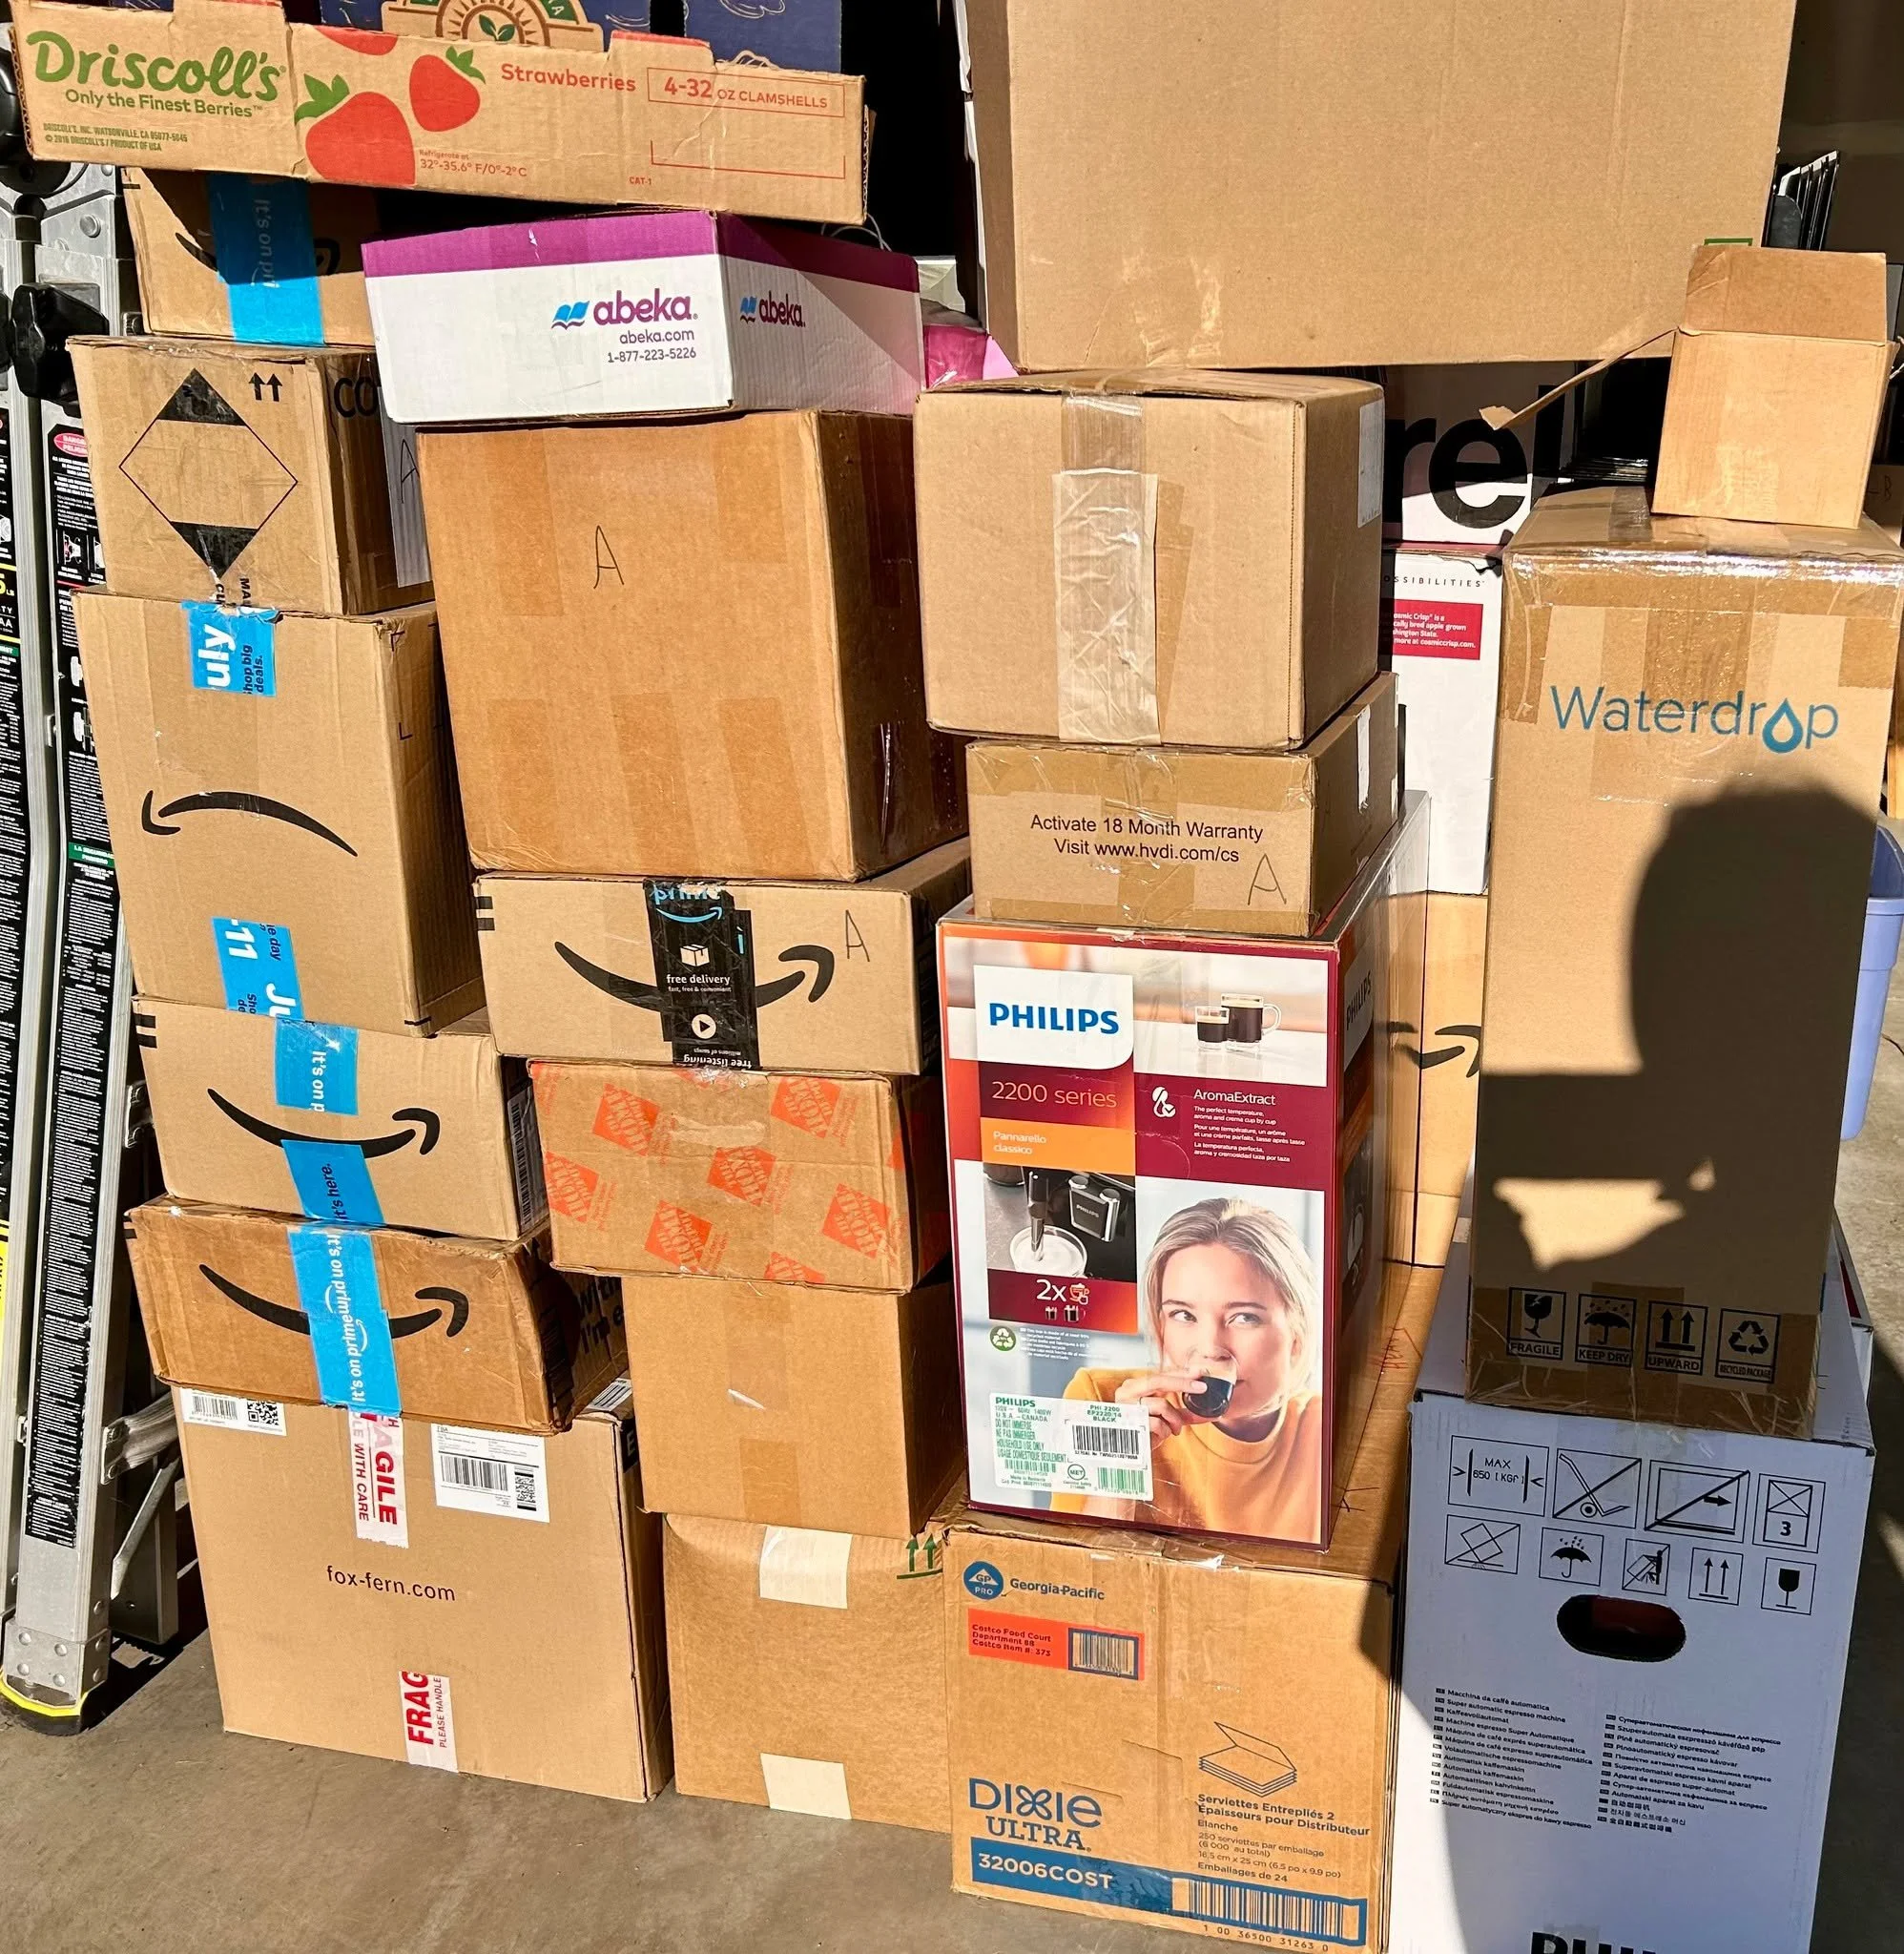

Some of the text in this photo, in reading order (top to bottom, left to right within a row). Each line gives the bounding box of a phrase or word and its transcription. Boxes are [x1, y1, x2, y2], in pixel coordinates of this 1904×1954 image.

[26, 30, 280, 101] Driscoll's
[502, 63, 636, 92] Strawberries
[66, 89, 103, 108] Only
[107, 93, 135, 108] the
[139, 94, 191, 112] Finest
[665, 76, 827, 109] 4-32 OZ CLAMSHELLS
[149, 142, 161, 151] USA
[259, 234, 273, 256] on
[593, 287, 692, 326] abeka
[619, 328, 694, 344] abeka.com
[608, 348, 696, 364] 1-877-223-5226
[334, 377, 382, 418] CO
[593, 525, 624, 590] A
[254, 655, 263, 693] deals.
[1550, 684, 1839, 755] Waterdrop
[1030, 814, 1263, 843] Activate 18 Month Warranty
[1054, 838, 1239, 863] Visit www.hvdi.com/cs
[1248, 854, 1287, 905] A
[845, 909, 870, 963] A
[667, 974, 730, 985] free delivery
[1346, 969, 1372, 1030] PHILIPS
[989, 1002, 1119, 1035] PHILIPS
[684, 1054, 752, 1069] free listening
[312, 1050, 326, 1099] It's on
[991, 1081, 1117, 1109] 2200 series
[1193, 1089, 1275, 1106] AromaExtract
[992, 1130, 1046, 1145] Pannarello
[993, 1143, 1033, 1155] classico
[321, 1163, 341, 1197] here.
[327, 1234, 342, 1257] It's
[331, 1261, 343, 1278] on
[1509, 1342, 1561, 1357] FRAGILE
[1578, 1348, 1630, 1364] KEEP DRY
[348, 1359, 363, 1378] on
[1648, 1356, 1700, 1372] UPWARD
[1719, 1363, 1745, 1377] RECYCLED
[350, 1381, 366, 1403] It's
[995, 1397, 1036, 1407] PHILIPS
[1473, 1469, 1490, 1480] 650
[1484, 1458, 1511, 1469] MAX
[354, 1444, 369, 1522] WITH CARE
[1779, 1520, 1791, 1537] 3
[326, 1565, 456, 1601] fox-fern.com
[976, 1574, 991, 1583] GP
[1010, 1578, 1105, 1600] Georgia-Pacific
[975, 1587, 993, 1596] PRO
[972, 1624, 1051, 1642] Costco Food Court
[972, 1632, 1022, 1645] Department
[972, 1639, 1002, 1649] Costco
[1447, 1689, 1480, 1701] Macchina
[402, 1671, 434, 1745] FRAG
[433, 1677, 447, 1748] PLEASE HANDLE
[1447, 1698, 1565, 1723] Super automatic espresso machine
[1446, 1717, 1475, 1728] Machine
[1477, 1723, 1506, 1735] espresso
[1508, 1727, 1527, 1736] Super
[1198, 1794, 1258, 1810] Serviettes
[1327, 1812, 1335, 1820] 2
[985, 1815, 1086, 1852] ULTRA
[1198, 1819, 1238, 1832] Blanche
[1266, 1815, 1293, 1825] pour
[1297, 1819, 1370, 1836] Distributeur
[1199, 1832, 1324, 1858] 250 serviettes par emballage
[1247, 1847, 1270, 1858] total)
[979, 1853, 1113, 1889] 32006COST
[1198, 1862, 1287, 1882] Emballages de 24
[1326, 1870, 1341, 1879] po)
[1217, 1927, 1230, 1936] 00
[1238, 1931, 1272, 1943] 36500
[1279, 1938, 1314, 1950] 31263
[1322, 1944, 1328, 1952] 0
